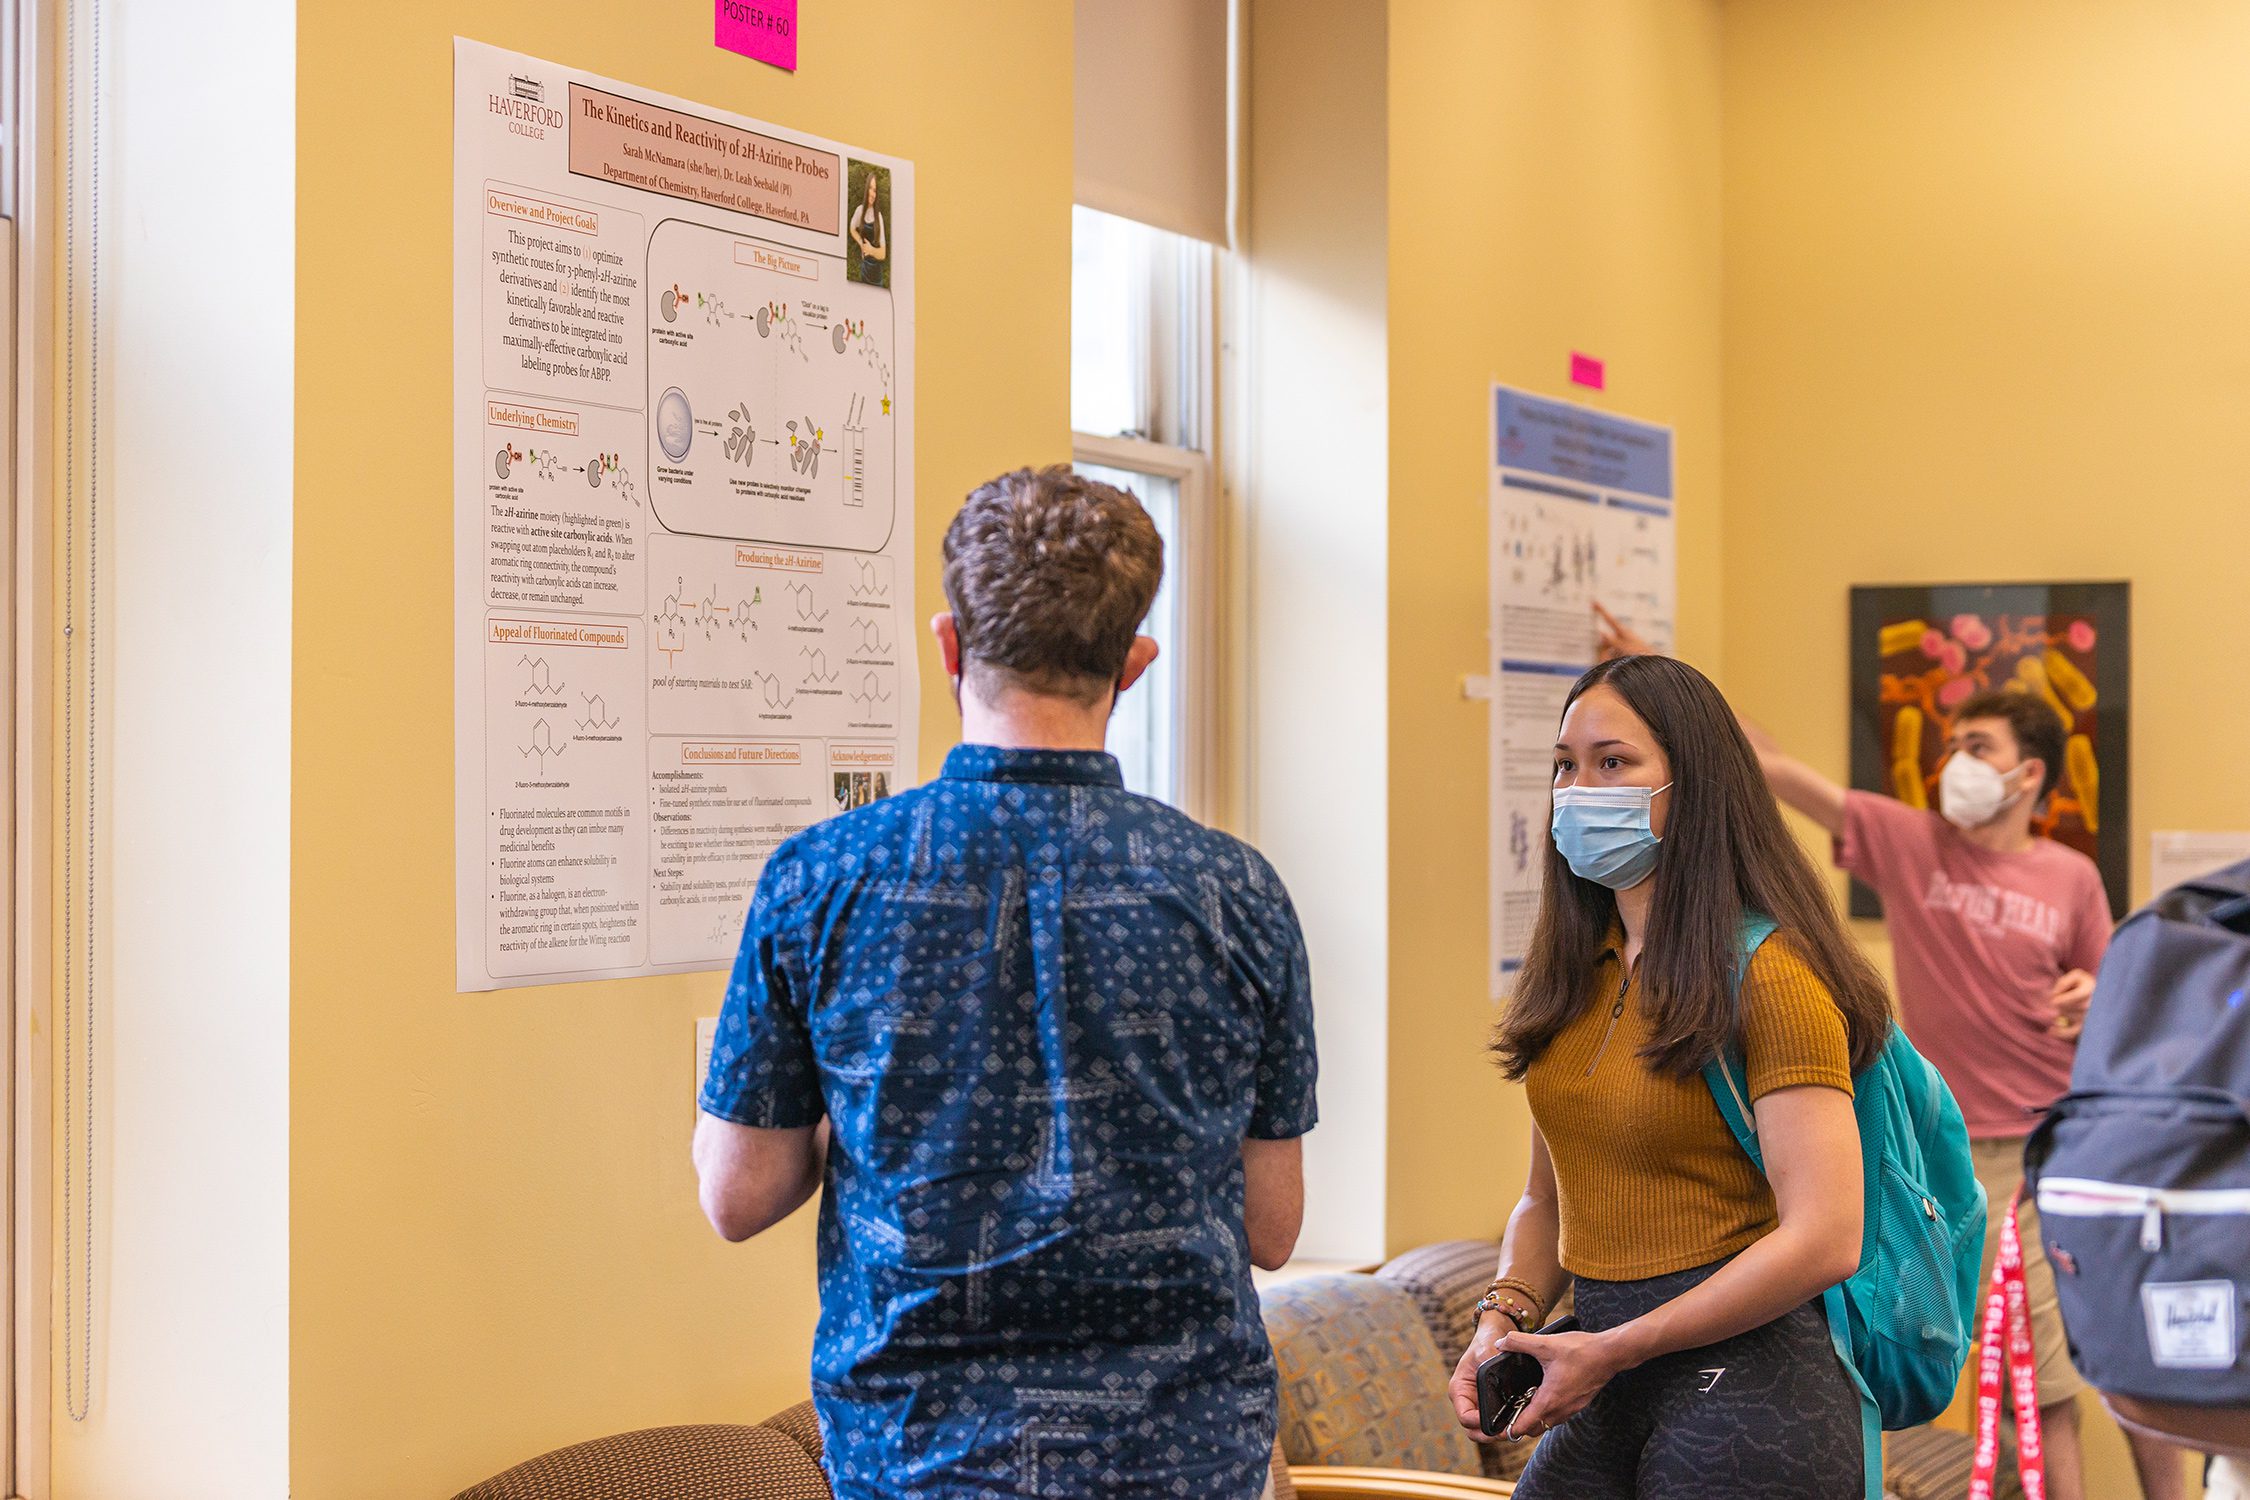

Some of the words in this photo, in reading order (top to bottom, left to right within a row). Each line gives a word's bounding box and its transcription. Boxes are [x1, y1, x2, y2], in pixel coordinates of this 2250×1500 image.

[723, 0, 764, 28] POSTER
[767, 14, 773, 31] #
[776, 17, 789, 36] 60
[489, 94, 563, 129] HAVERFORD
[508, 121, 545, 141] COLLEGE
[582, 98, 604, 121] The
[606, 105, 649, 133] Kinetics
[651, 121, 672, 139] and
[675, 123, 728, 158] Reactivity
[729, 138, 741, 156] of
[741, 142, 793, 171] 2H-Azirine
[795, 156, 829, 180] Probes
[623, 143, 644, 160] Sarah
[645, 148, 686, 170] McNamara
[686, 158, 723, 180] (she/her),
[724, 168, 734, 182] Dr.
[736, 171, 753, 186] Leah
[753, 176, 779, 193] Seebald
[780, 183, 792, 198] (PI)
[603, 162, 648, 186] Department
[648, 174, 658, 188] of
[658, 176, 700, 200] Chemistry,
[701, 186, 736, 206] Haverford
[736, 195, 765, 215] College,
[766, 202, 800, 223] Haverford,
[800, 211, 810, 224] PA
[489, 196, 529, 215] Overview
[529, 206, 545, 220] and
[546, 208, 574, 226] Project
[575, 214, 597, 231] Goals
[508, 229, 526, 246] This
[527, 236, 554, 252] project
[554, 240, 573, 256] aims
[573, 246, 582, 257] to
[583, 245, 591, 261] (1)
[592, 250, 623, 266] optimize
[492, 250, 529, 267] synthetic
[530, 258, 555, 272] routes
[555, 259, 566, 274] for
[567, 264, 637, 289] 3-phenyl-2H-azirine
[753, 250, 766, 264] The
[767, 254, 778, 270] Big
[778, 256, 801, 273] Picture
[500, 269, 542, 290] derivatives
[543, 279, 558, 293] and
[560, 281, 569, 298] (2)
[571, 283, 599, 304] identify
[600, 288, 612, 303] the
[613, 295, 630, 307] most
[507, 290, 548, 315] kinetically
[548, 298, 582, 318] favorable
[582, 307, 596, 320] and
[597, 311, 625, 326] reactive
[508, 311, 550, 332] derivatives
[551, 322, 560, 334] to
[560, 320, 570, 335] be
[571, 323, 607, 342] integrated
[608, 330, 623, 345] into
[503, 334, 576, 356] maximally-effective
[577, 345, 613, 364] carboxylic
[613, 352, 628, 365] acid
[521, 354, 552, 377] labeling
[552, 362, 578, 377] probes
[579, 364, 590, 379] for
[590, 367, 612, 382] ABPP.
[490, 407, 535, 429] Underlying
[536, 413, 576, 434] Chemistry
[668, 467, 684, 476] bacteria
[491, 505, 504, 517] The
[504, 506, 539, 521] 2H-azirine
[540, 511, 560, 525] moiety
[562, 512, 598, 528] (highlighted
[599, 516, 605, 527] in
[605, 519, 624, 530] green)
[625, 519, 631, 530] is
[491, 523, 516, 534] reactive
[516, 524, 530, 535] with
[530, 526, 550, 538] active
[550, 527, 563, 539] site
[563, 529, 596, 544] carboxylic
[596, 532, 614, 543] acids.
[615, 533, 633, 545] When
[490, 540, 521, 554] swapping
[521, 544, 532, 552] out
[532, 544, 548, 554] atom
[549, 543, 586, 557] placeholders
[594, 548, 606, 559] and
[615, 552, 622, 560] to
[622, 550, 636, 561] alter
[737, 550, 774, 567] Producing
[773, 554, 785, 566] the
[784, 555, 822, 569] 2H-Azirine
[490, 556, 519, 568] aromatic
[520, 557, 533, 571] ring
[533, 560, 570, 574] connectivity,
[571, 561, 581, 573] the
[491, 572, 520, 587] reactivity
[521, 573, 535, 585] with
[535, 575, 565, 589] carboxylic
[566, 577, 582, 589] acids
[582, 581, 593, 589] can
[593, 579, 619, 592] increase,
[490, 587, 521, 601] decrease,
[521, 593, 528, 601] or
[529, 591, 550, 602] remain
[550, 592, 584, 606] unchanged.
[493, 625, 522, 642] Appeal
[523, 625, 532, 639] of
[533, 626, 578, 641] Fluorinated
[579, 629, 625, 646] Compounds
[652, 675, 667, 690] pool
[668, 675, 676, 690] of
[674, 676, 698, 691] starting
[699, 678, 721, 689] materials
[721, 681, 728, 689] to
[728, 681, 740, 689] test
[684, 747, 725, 760] Conclusions
[724, 748, 737, 760] and
[738, 748, 764, 760] Future
[764, 748, 800, 760] Directions
[831, 750, 894, 762] Acknowledgements
[652, 770, 704, 782] Accomplishments:
[500, 808, 535, 820] Fluorinated
[536, 807, 566, 819] molecules
[567, 810, 577, 818] are
[577, 810, 604, 818] common
[605, 806, 624, 817] motifs
[624, 809, 630, 817] in
[653, 812, 692, 822] Observations:
[653, 868, 667, 878] Next
[667, 868, 684, 879] Steps:
